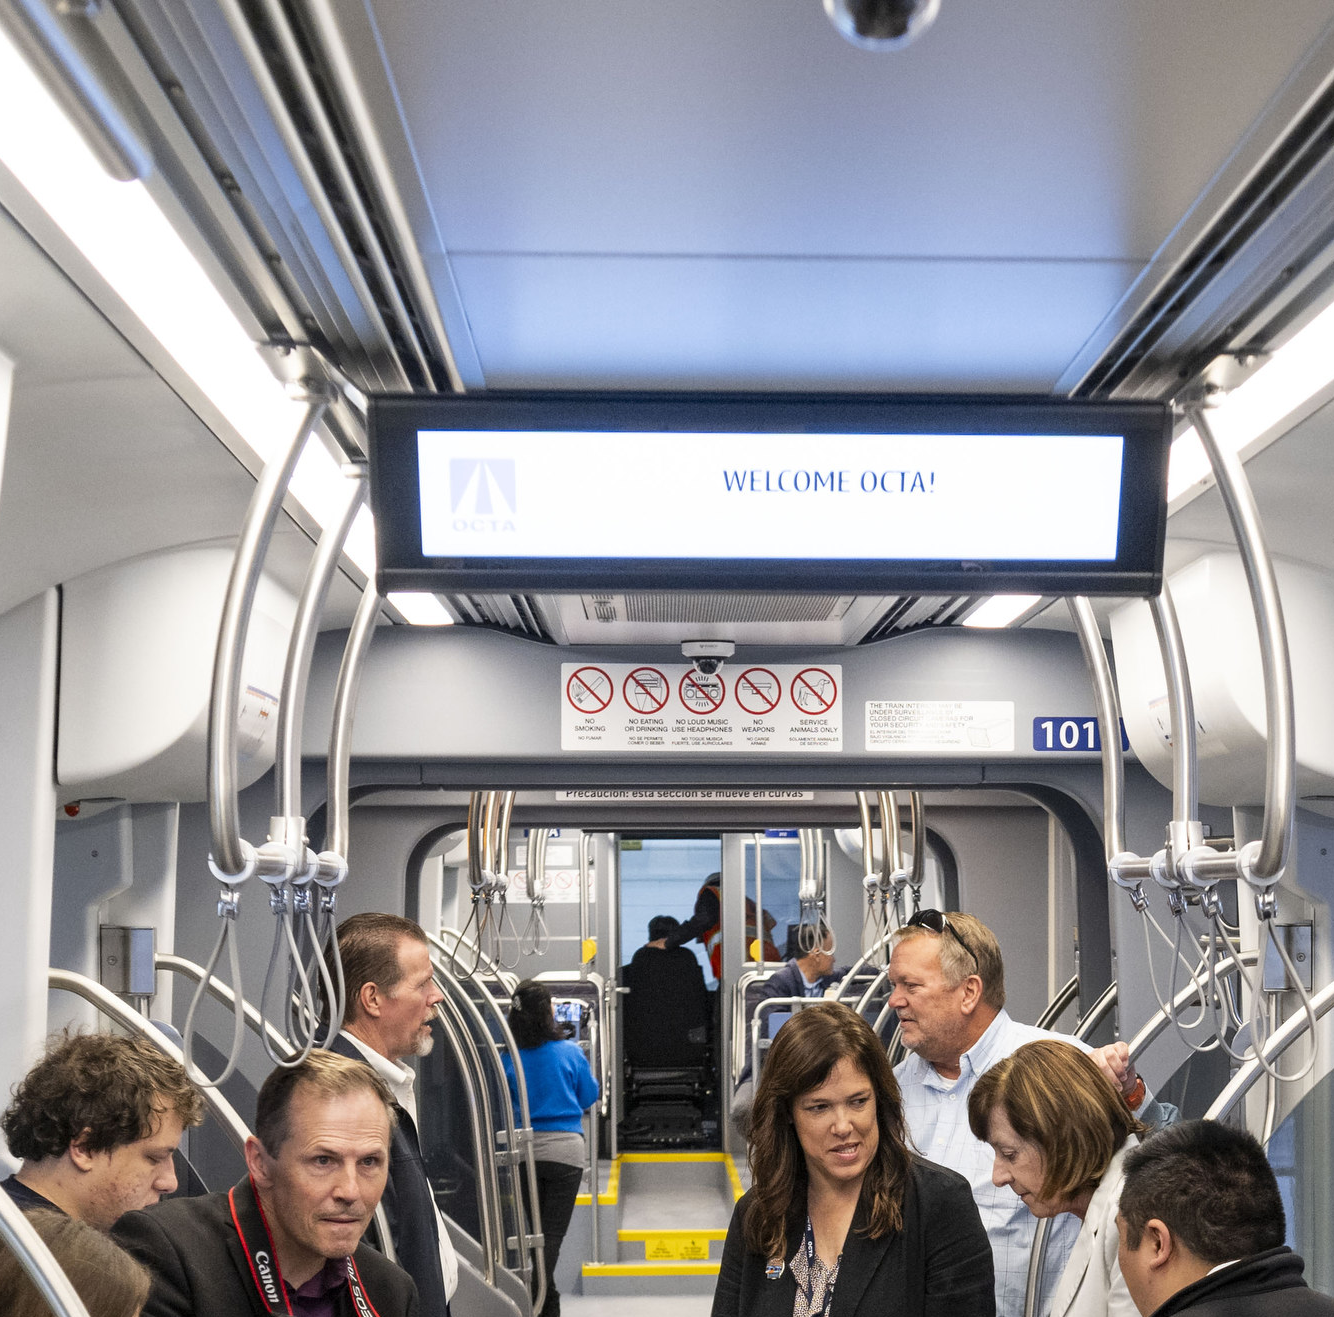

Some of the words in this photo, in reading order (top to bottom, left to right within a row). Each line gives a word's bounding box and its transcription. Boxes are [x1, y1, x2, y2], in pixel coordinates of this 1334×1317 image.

[723, 470, 850, 493] WELCOME
[860, 470, 935, 493] OCTA!
[452, 519, 516, 532] OCTA
[1041, 721, 1095, 749] 101
[632, 790, 654, 798] esta
[700, 790, 713, 798] se
[715, 790, 750, 798] mueve
[752, 790, 765, 798] en
[768, 790, 804, 798] curvas
[255, 1251, 280, 1303] Canon
